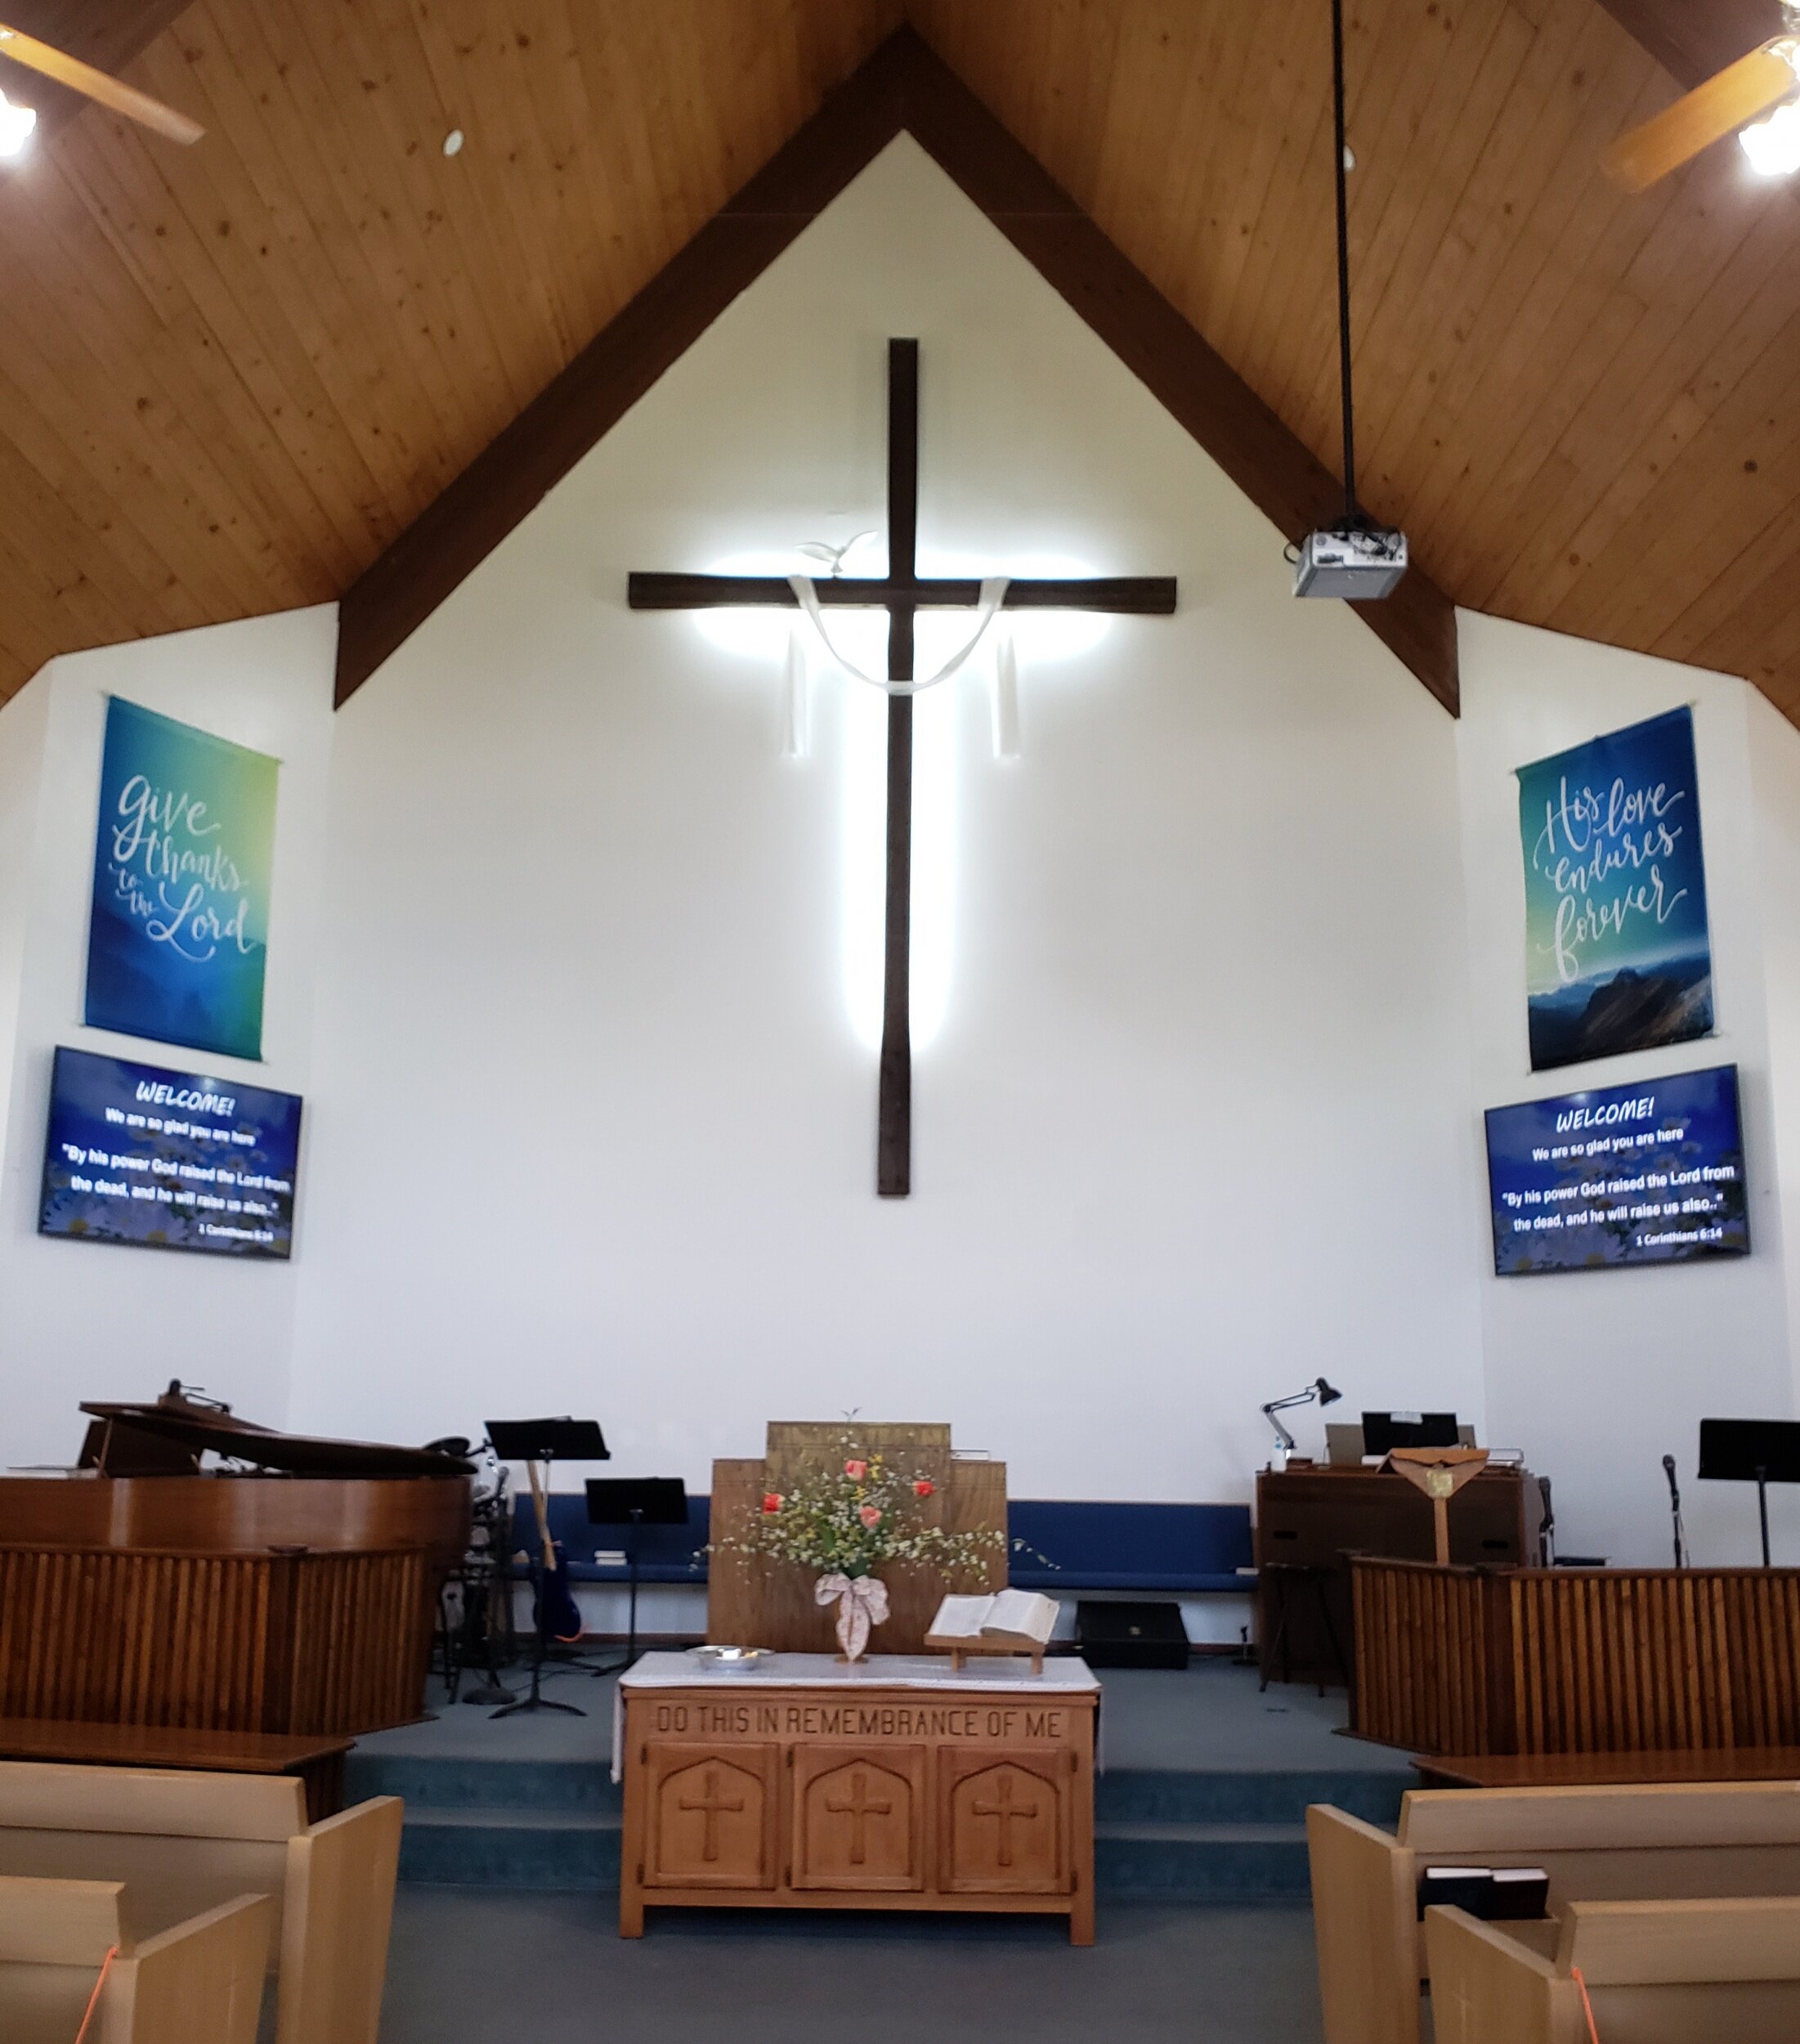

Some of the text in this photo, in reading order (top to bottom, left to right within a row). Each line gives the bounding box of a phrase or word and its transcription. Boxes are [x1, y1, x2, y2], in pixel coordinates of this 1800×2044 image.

[114, 774, 222, 862] give
[1534, 775, 1685, 869] His love
[108, 863, 143, 890] to
[113, 826, 249, 892] thanks
[1545, 822, 1682, 894] endures
[146, 881, 257, 962] Lord
[1537, 863, 1687, 983] forever
[135, 1080, 236, 1117] WELCOME!
[1556, 1096, 1654, 1133] WELCOME!
[105, 1107, 125, 1124] We
[126, 1112, 146, 1127] are
[147, 1117, 163, 1130] so
[163, 1118, 190, 1136] glad
[190, 1125, 212, 1140] you
[212, 1128, 231, 1143] are
[1533, 1127, 1684, 1162] We are so glad you are here
[88, 1148, 109, 1166] his
[110, 1154, 150, 1172] power
[151, 1158, 177, 1176] God
[179, 1164, 216, 1181] raised
[217, 1168, 236, 1185] the
[237, 1171, 263, 1188] Lord
[264, 1176, 291, 1192] from
[1525, 1190, 1542, 1204] his
[1544, 1186, 1578, 1205] power
[1580, 1180, 1605, 1197] God
[1608, 1176, 1646, 1193] raised
[1647, 1172, 1668, 1188] the
[1670, 1168, 1701, 1186] Lord
[1703, 1165, 1735, 1181] from
[71, 1175, 92, 1192] the
[94, 1178, 129, 1199] dead,
[131, 1186, 155, 1200] and
[174, 1190, 196, 1206] will
[196, 1193, 226, 1210] raise
[226, 1199, 242, 1213] us
[1514, 1217, 1531, 1232] the
[1534, 1213, 1564, 1229] dead,
[1566, 1210, 1587, 1226] and
[1590, 1209, 1605, 1223] he
[1607, 1204, 1628, 1221] will
[1630, 1203, 1661, 1218] raise
[1663, 1202, 1680, 1215] us
[1636, 1226, 1722, 1247] 1 Corinthians 6:14
[656, 1706, 1063, 1738] DO THIS IN REMEMBRANCE OF ME
